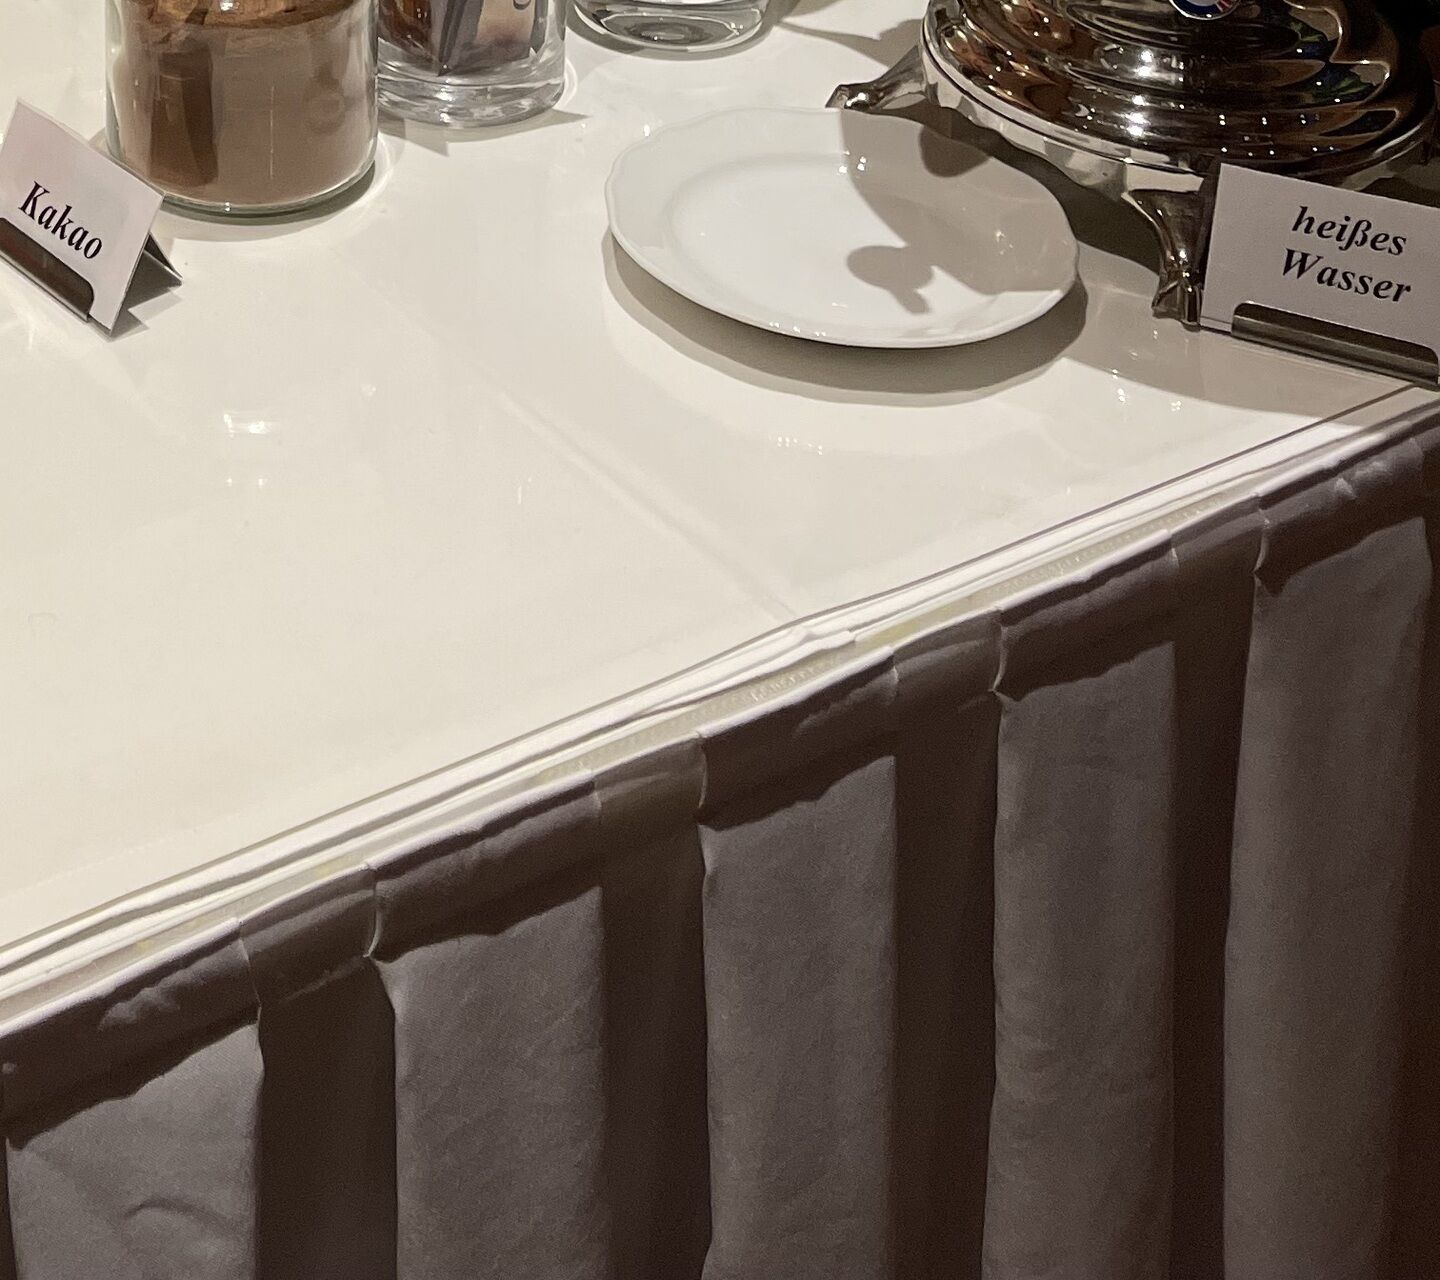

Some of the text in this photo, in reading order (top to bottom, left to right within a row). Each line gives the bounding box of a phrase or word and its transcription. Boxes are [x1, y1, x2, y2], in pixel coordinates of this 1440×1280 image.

[17, 180, 103, 260] Kakao
[1291, 205, 1407, 257] heißes
[1282, 247, 1412, 302] Wasser
